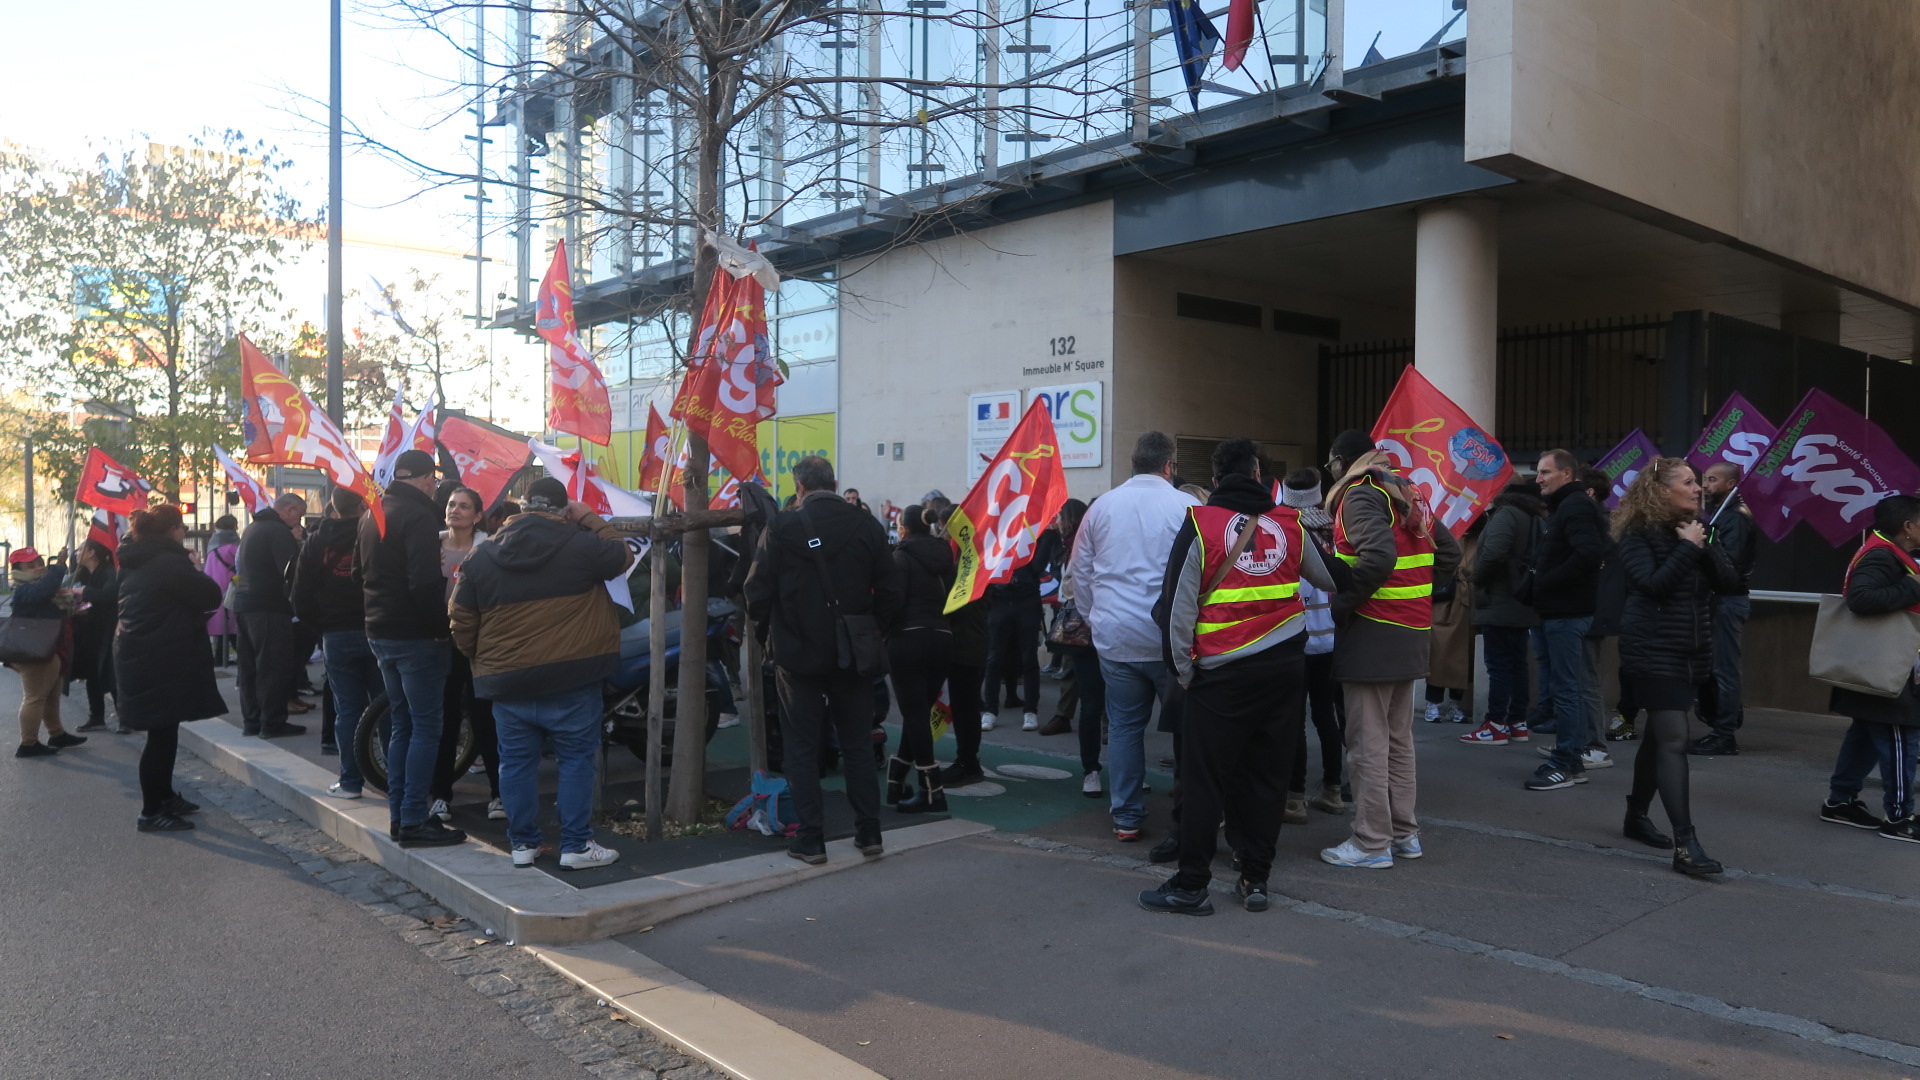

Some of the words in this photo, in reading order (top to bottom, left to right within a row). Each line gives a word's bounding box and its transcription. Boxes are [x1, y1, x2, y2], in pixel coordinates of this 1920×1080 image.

[1050, 335, 1076, 356] 132
[1022, 364, 1062, 376] Immeuble
[1075, 360, 1105, 372] Square
[1698, 407, 1744, 458] Solidaires
[1755, 408, 1816, 479] Solidaires
[1461, 437, 1496, 466] FSM
[1836, 440, 1862, 461] Santé
[1860, 457, 1889, 491] Sociaux
[1239, 554, 1254, 562] CGT
